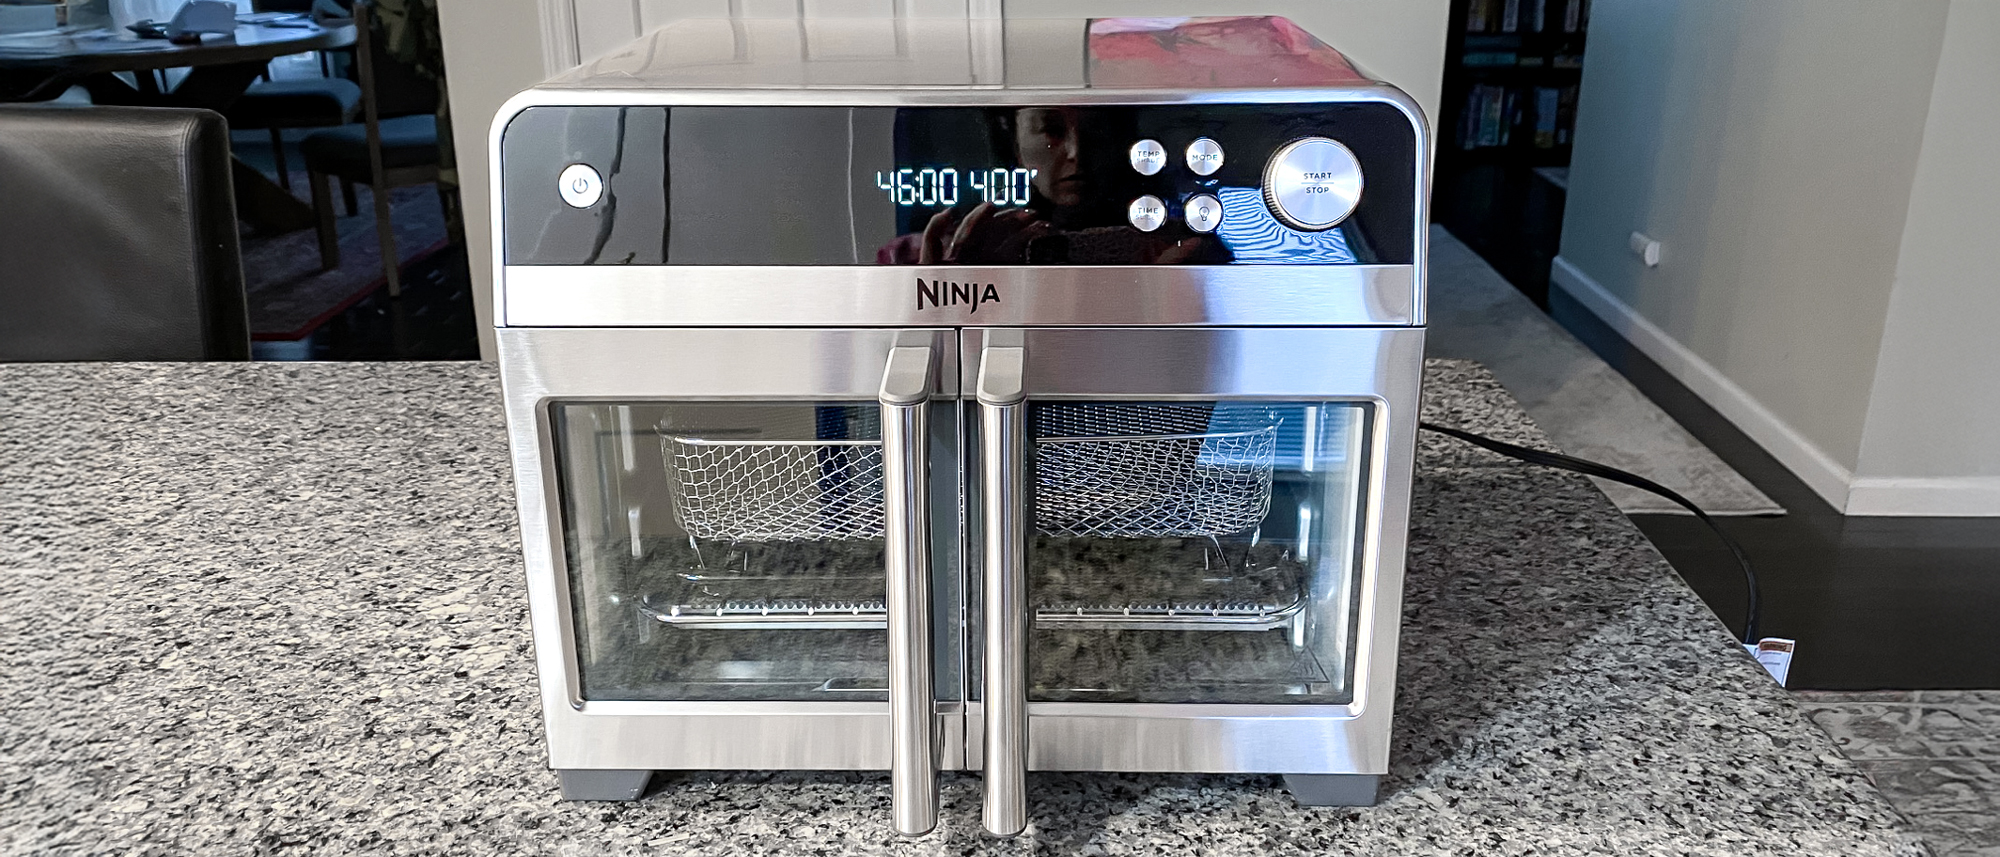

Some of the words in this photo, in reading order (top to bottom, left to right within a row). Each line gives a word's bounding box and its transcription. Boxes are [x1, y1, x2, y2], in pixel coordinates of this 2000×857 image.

[1137, 150, 1161, 158] TEMP
[1303, 172, 1332, 180] START
[876, 168, 958, 205] 46:00
[1306, 186, 1330, 194] STOP
[916, 277, 1001, 315] NINJA
